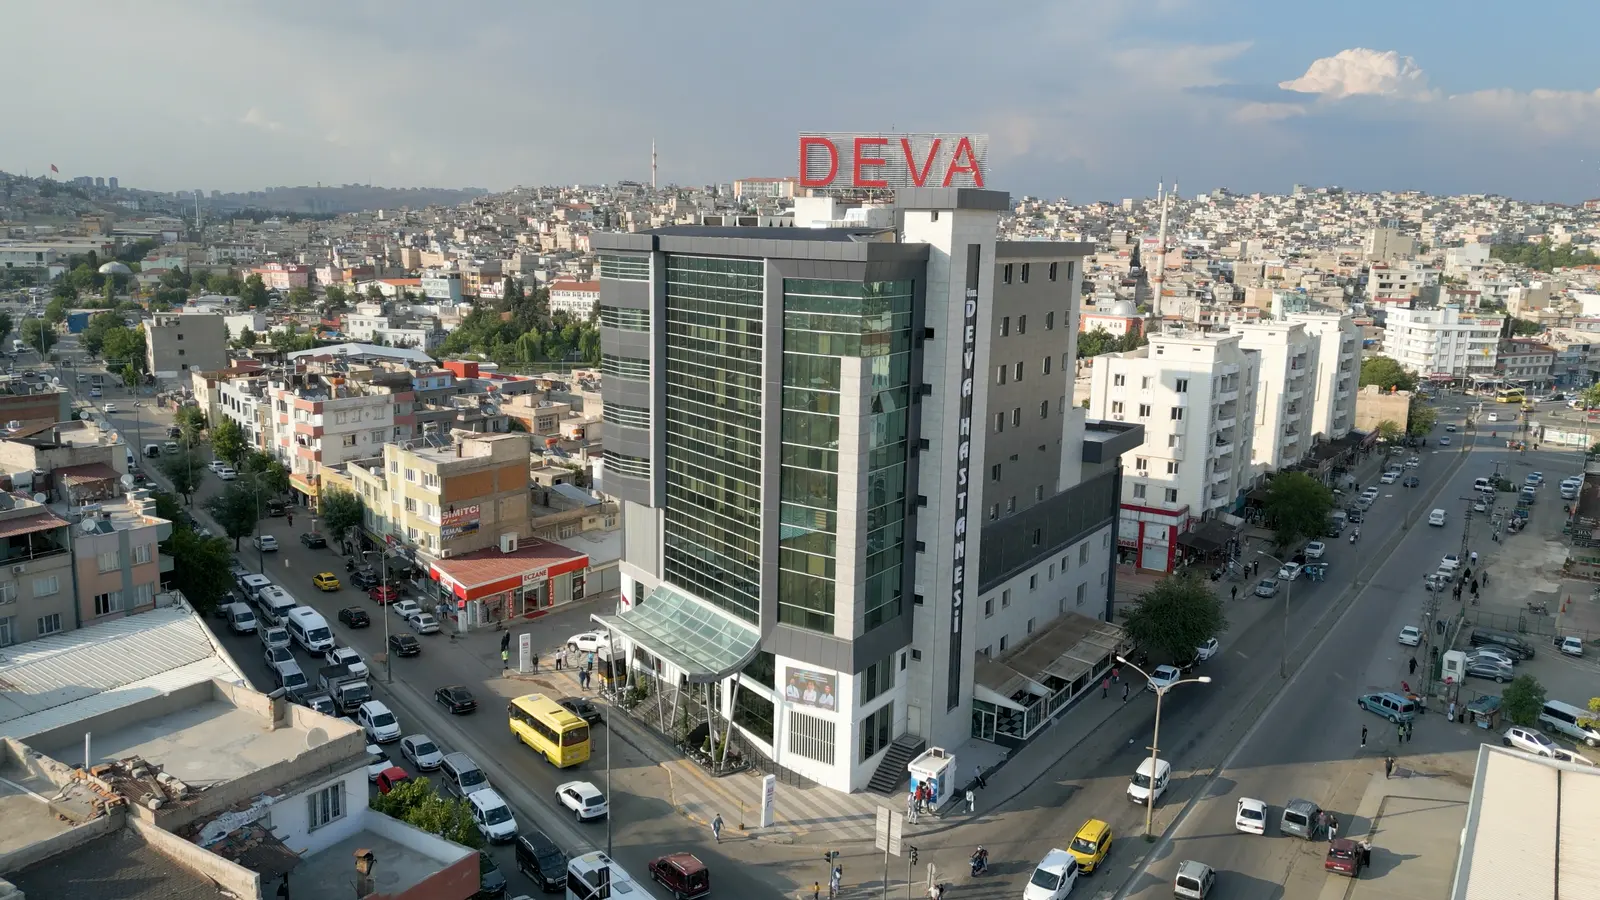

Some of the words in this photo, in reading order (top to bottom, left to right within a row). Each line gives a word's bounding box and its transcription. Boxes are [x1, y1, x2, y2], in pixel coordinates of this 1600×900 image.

[799, 136, 985, 188] DEVA
[961, 300, 976, 398] DEVA
[523, 569, 547, 581] ECZANE
